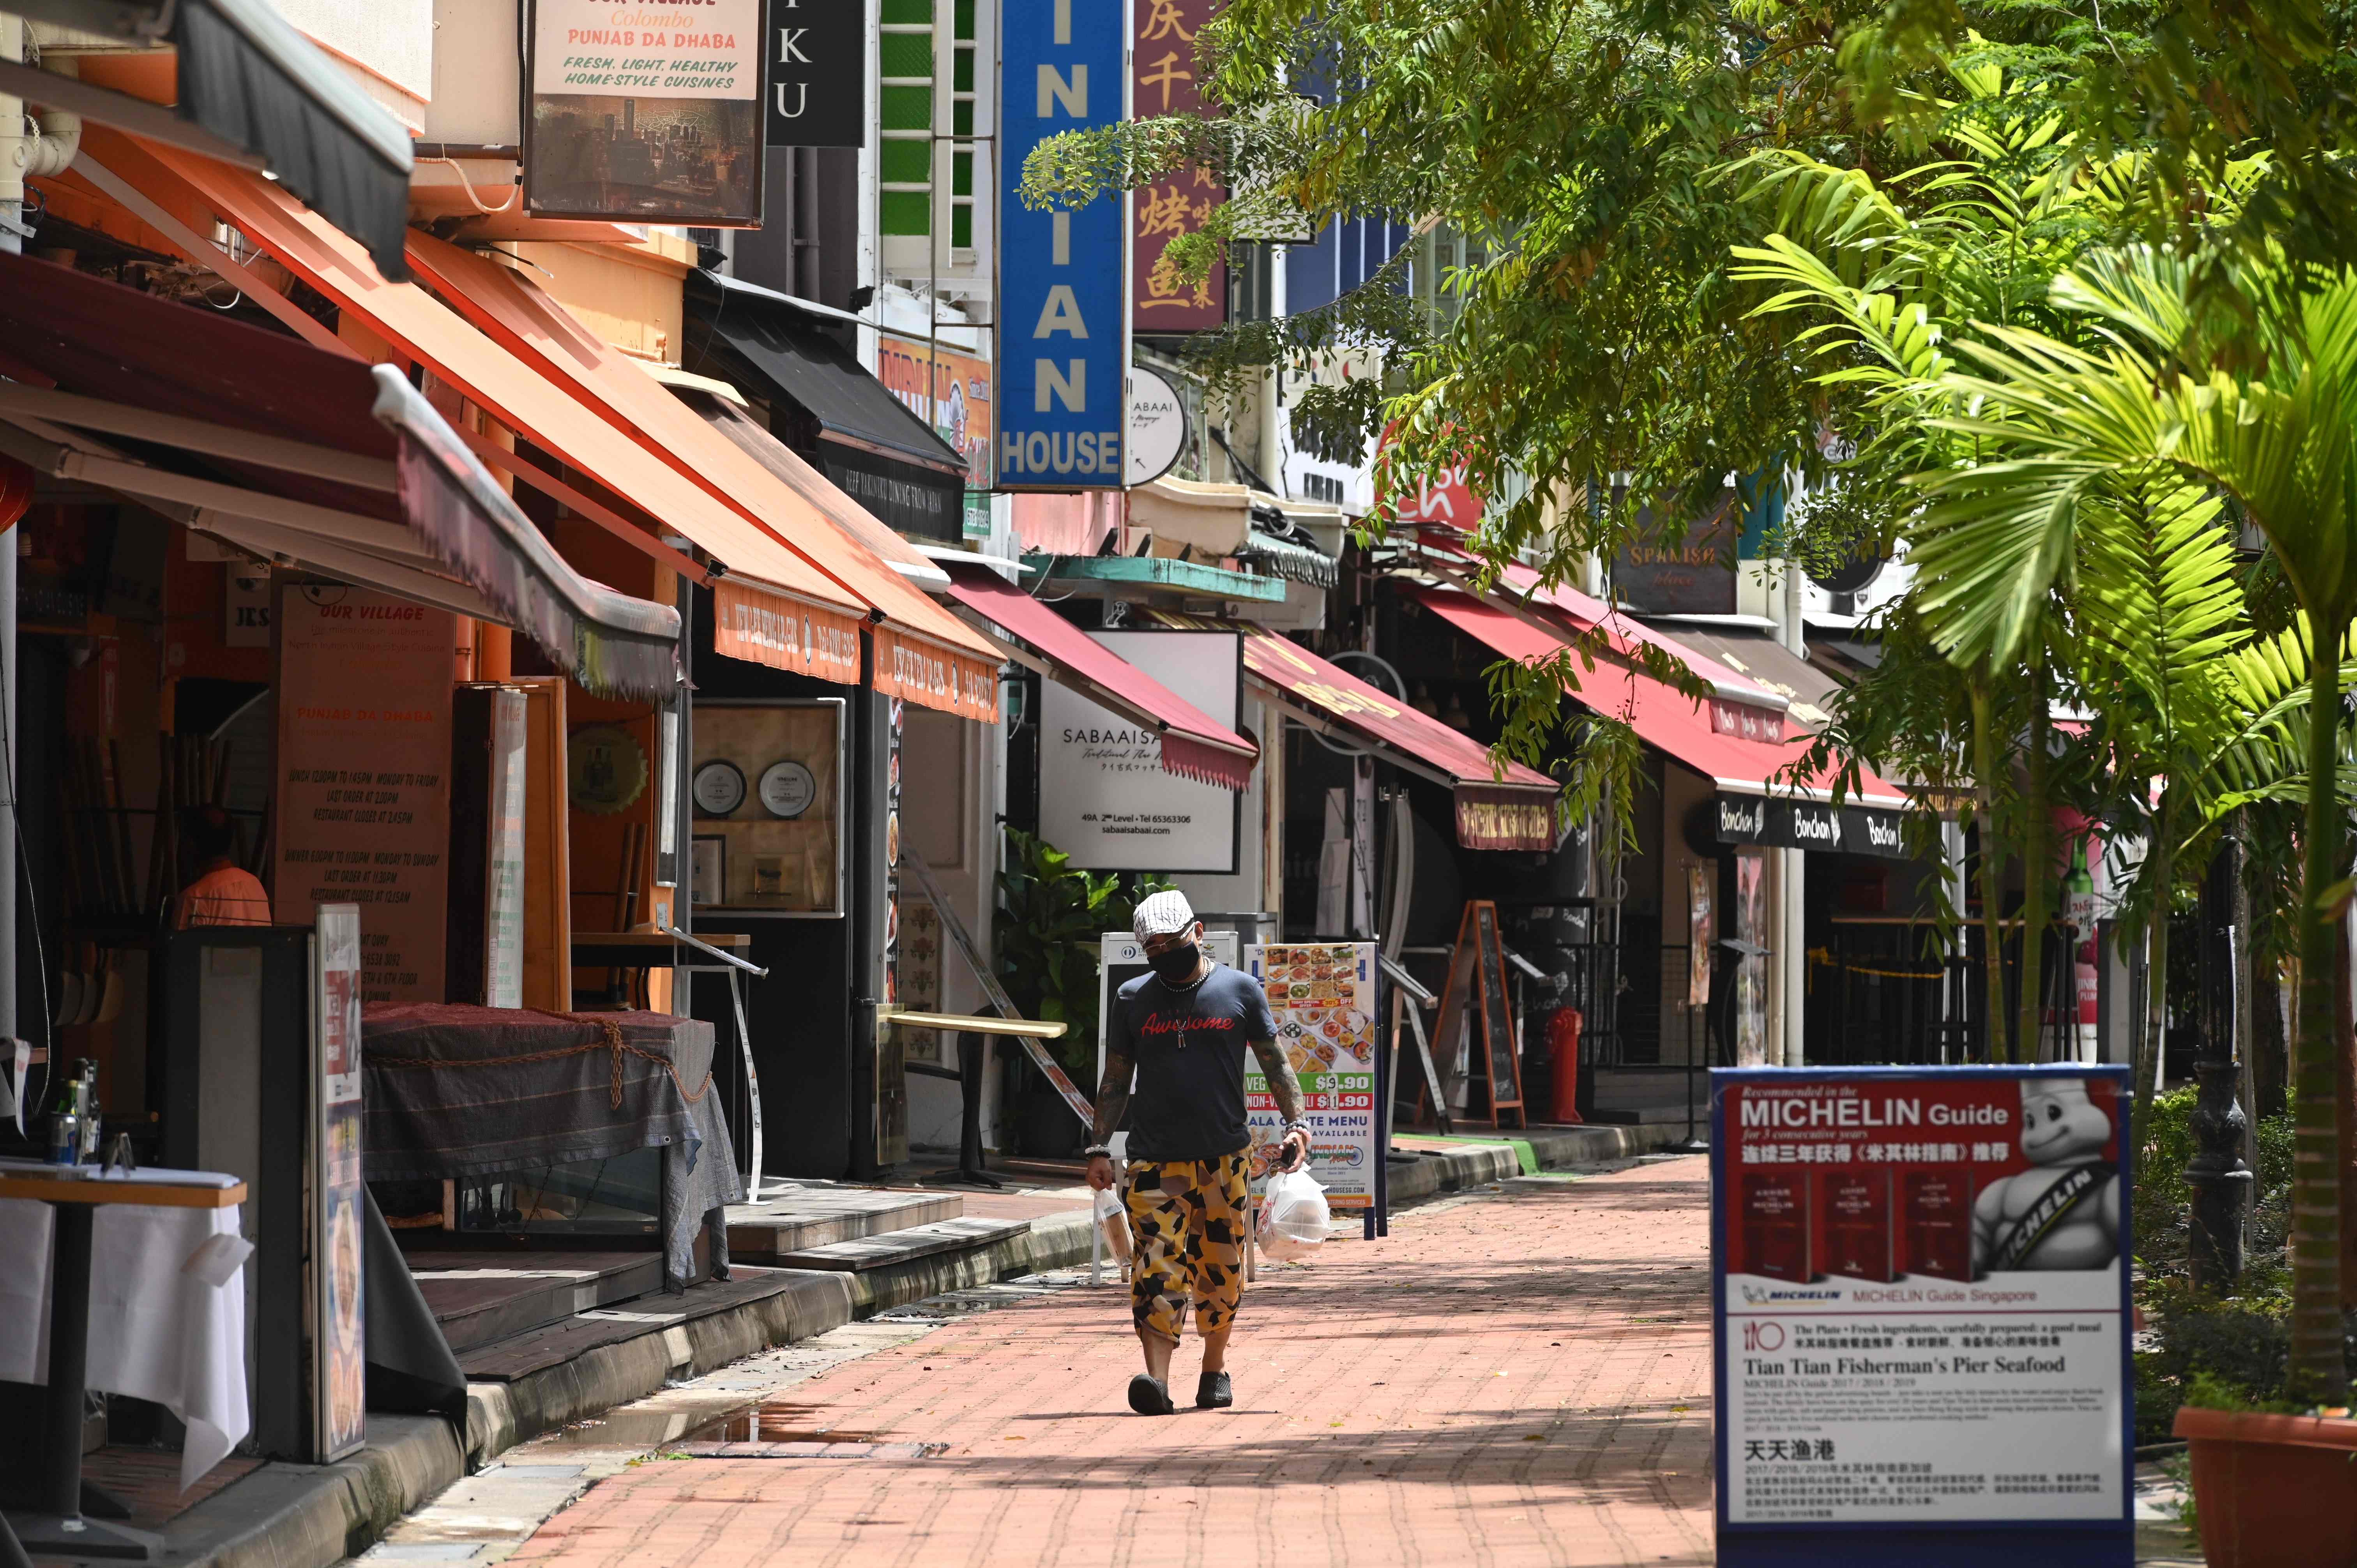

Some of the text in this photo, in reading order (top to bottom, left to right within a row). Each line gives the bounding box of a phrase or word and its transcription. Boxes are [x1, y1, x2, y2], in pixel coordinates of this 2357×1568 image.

[611, 10, 694, 28] Colombo
[568, 29, 735, 49] PUNJAB DA DHABA
[774, 0, 812, 117] KU
[670, 61, 738, 72] HEALTHY
[565, 73, 734, 89] HOME-STYLE CUISINES
[1139, 0, 1195, 308] 庆千烤鱼
[1033, 0, 1088, 412] INIAN
[1001, 431, 1118, 473] HOUSE
[861, 472, 887, 500] YAKINIKU
[889, 480, 910, 506] DINING
[320, 606, 424, 620] OUR VILLAGE
[297, 708, 434, 723] PUNJAB DA DHABA
[288, 769, 310, 782] LUNCH
[339, 771, 347, 784] TO
[376, 773, 404, 786] MONDAY
[405, 773, 413, 786] TO
[415, 773, 439, 787] FRIDAY
[327, 790, 342, 803] LAST
[343, 790, 364, 803] ORDER
[365, 791, 374, 803] AT
[313, 808, 354, 821] RESTAURANT
[355, 810, 377, 823] CLOSES
[378, 811, 386, 823] AT
[1721, 800, 1753, 833] Bonchon
[1102, 826, 1170, 835] sabaaisabaai.com
[1794, 807, 1831, 840] Bonchon
[336, 851, 345, 863] TO
[374, 852, 401, 865] MONDAY
[403, 853, 412, 865] TO
[413, 853, 440, 867] SUNDAY
[324, 870, 340, 882] LAST
[341, 871, 361, 883] ORDER
[362, 871, 371, 883] AT
[310, 888, 350, 901] RESTAURANT
[352, 890, 374, 902] CLOSES
[375, 890, 383, 902] AT
[371, 934, 390, 947] QUAY
[398, 973, 418, 985] FLOOR
[1141, 1013, 1235, 1035] Awesome
[1247, 1076, 1266, 1091] VEG
[1742, 1086, 1857, 1097] Recommended in the
[1740, 1098, 2009, 1127] MICHELIN Guide
[1248, 1116, 1368, 1126] ALA CTE MENU
[1742, 1130, 1868, 1142] for 3 consecutive years
[1311, 1144, 1354, 1160] INDIAN
[1770, 1289, 2038, 1304] MICHELIN MICHELIN Guide Singapore
[1794, 1324, 1812, 1334] The
[1816, 1324, 1841, 1334] Plate
[1851, 1324, 1880, 1334] Fresh
[1943, 1323, 1986, 1334] carefully
[2050, 1323, 2074, 1334] good
[2077, 1323, 2102, 1332] meal
[1743, 1356, 2065, 1375] Tian Tian Fisherman's Pier Seafood
[1744, 1378, 1916, 1388] MICHELIN Guide 2017 2018 2019
[1745, 1439, 1835, 1461] 天天渔港
